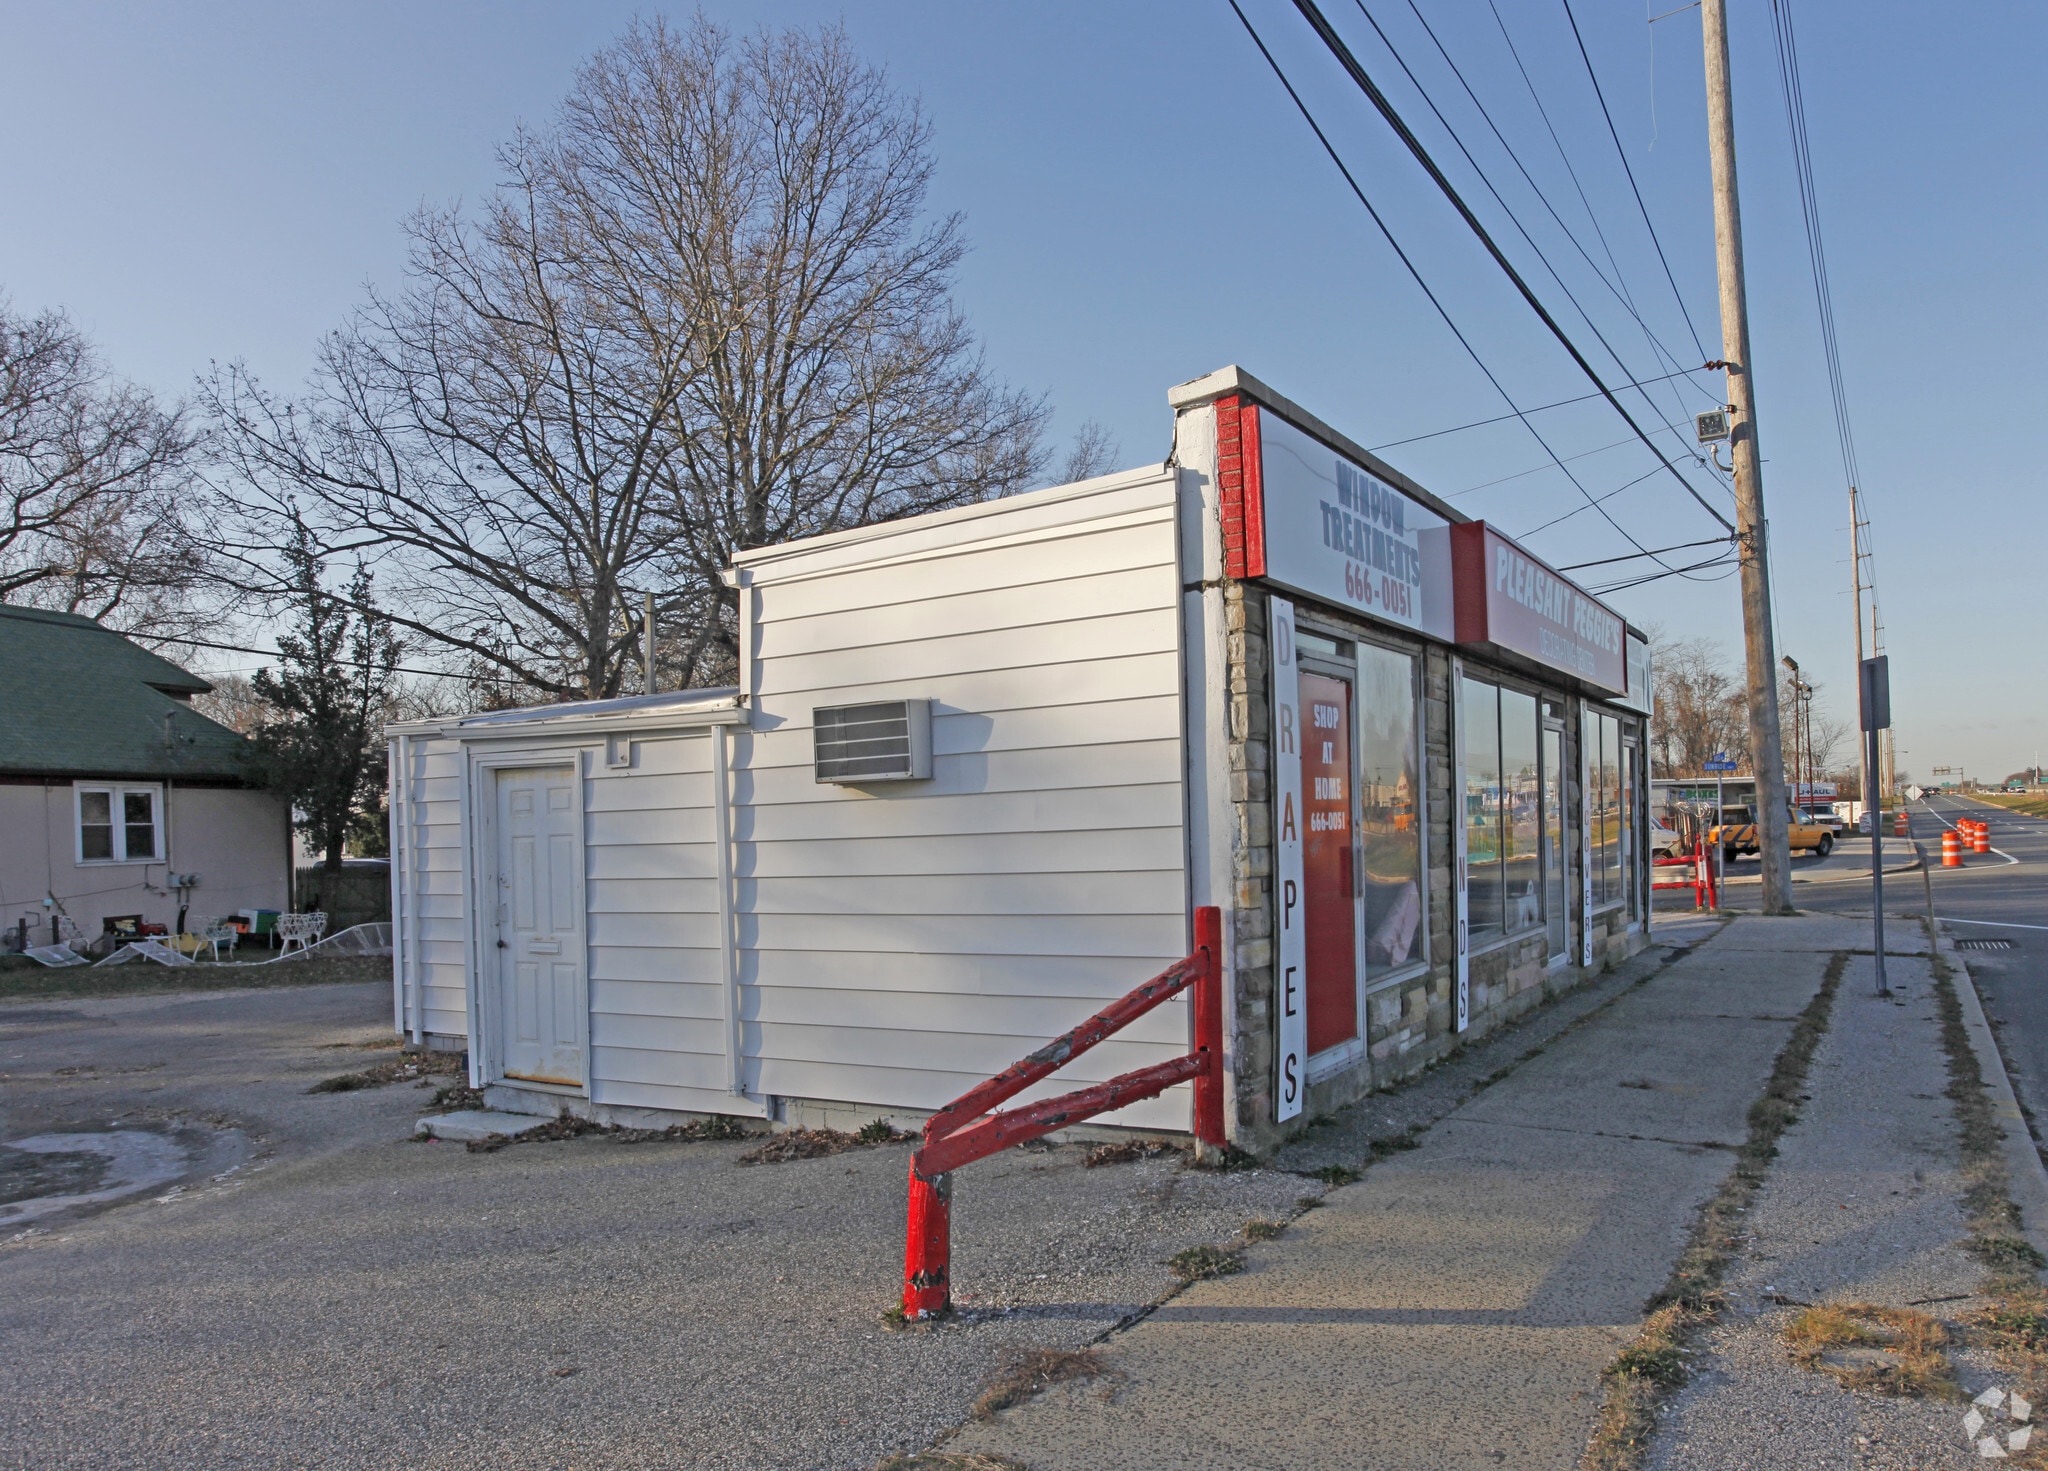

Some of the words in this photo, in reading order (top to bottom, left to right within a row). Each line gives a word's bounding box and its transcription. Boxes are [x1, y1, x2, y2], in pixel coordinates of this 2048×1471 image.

[1335, 460, 1404, 537] WINDOW
[1320, 499, 1420, 587] TREATMENTS
[1345, 560, 1412, 619] 666-0051
[1496, 545, 1570, 628] PLEASANT
[1574, 595, 1620, 656] PEGGIE'S
[1313, 704, 1339, 729] SHOP
[1322, 741, 1333, 764] AT
[1314, 777, 1342, 800] HOME
[1310, 811, 1346, 832] 666-0051
[1276, 615, 1297, 1104] DRAPES
